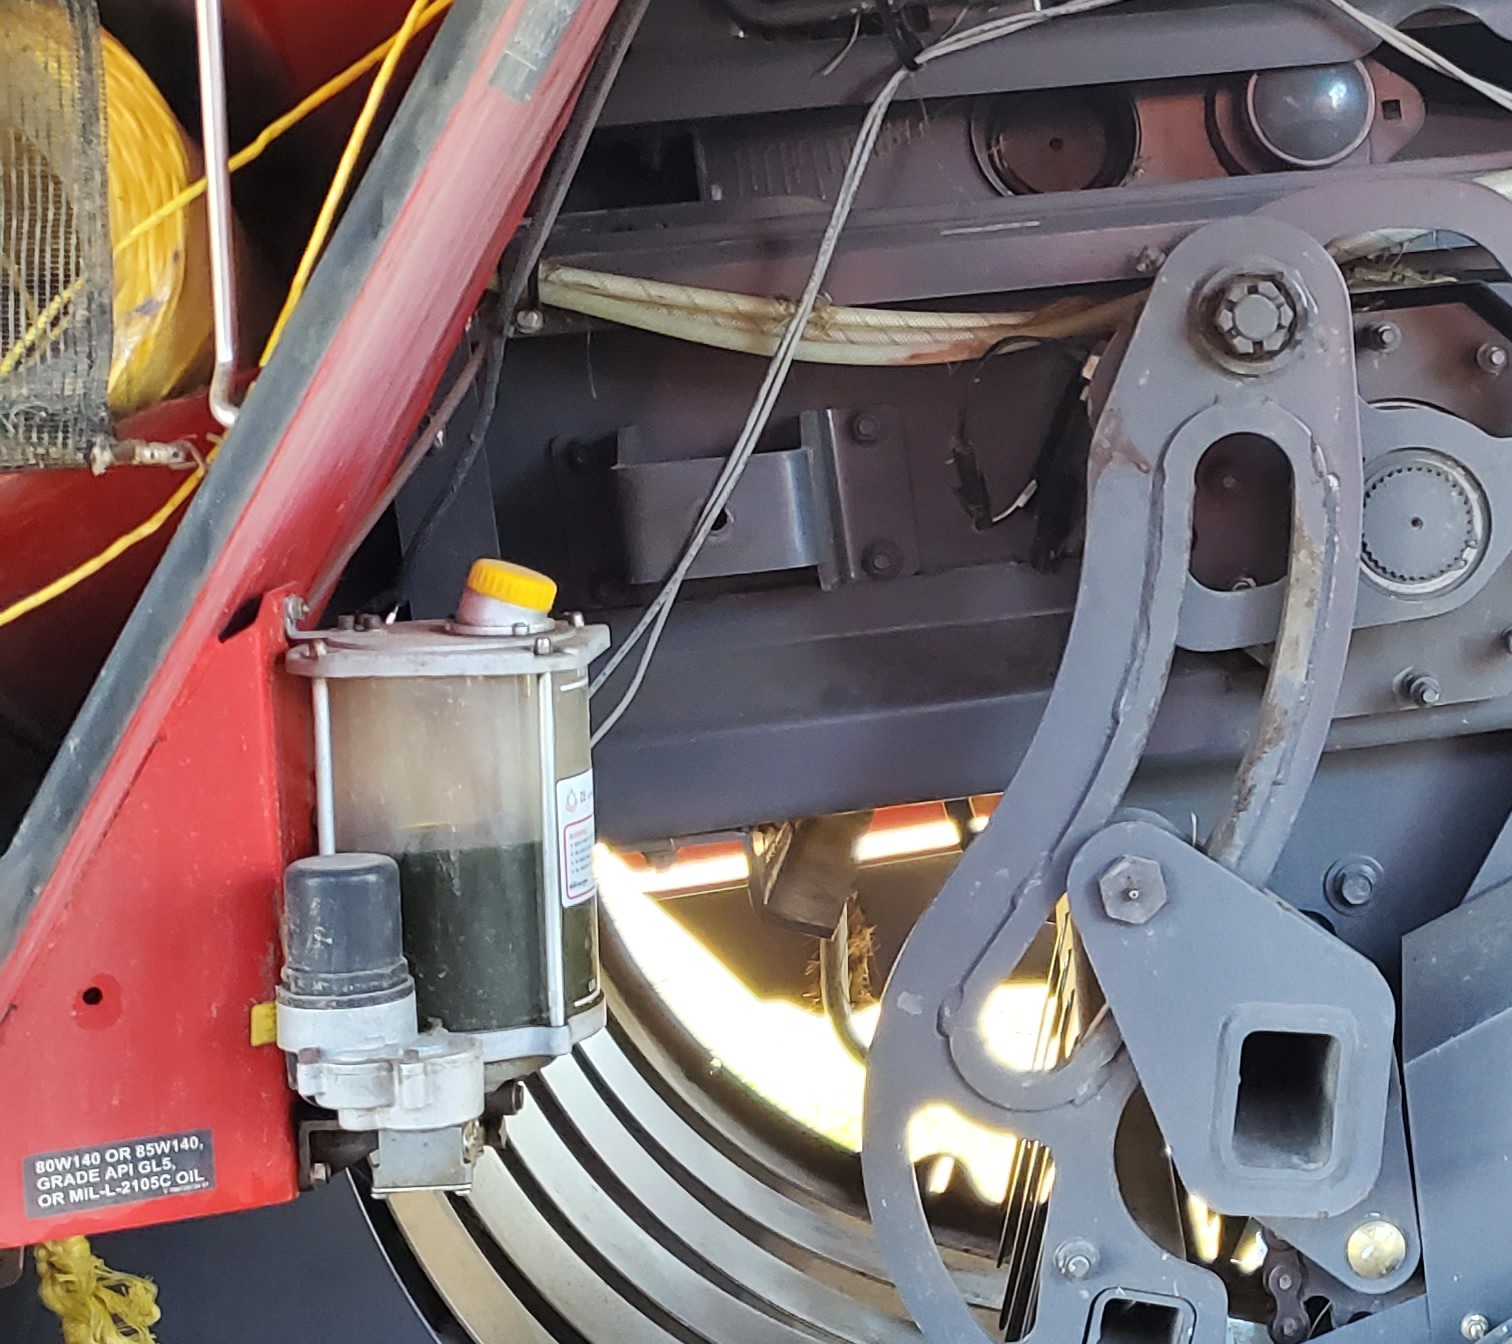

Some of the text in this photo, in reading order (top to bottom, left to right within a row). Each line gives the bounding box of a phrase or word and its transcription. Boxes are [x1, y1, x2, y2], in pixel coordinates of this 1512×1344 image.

[35, 1136, 204, 1174] 80W140 OR 85W140,
[36, 1157, 176, 1191] GRADE API GL5,
[37, 1192, 65, 1208] OR
[69, 1174, 171, 1203] MIL-L-2105C
[176, 1169, 205, 1185] OIL
